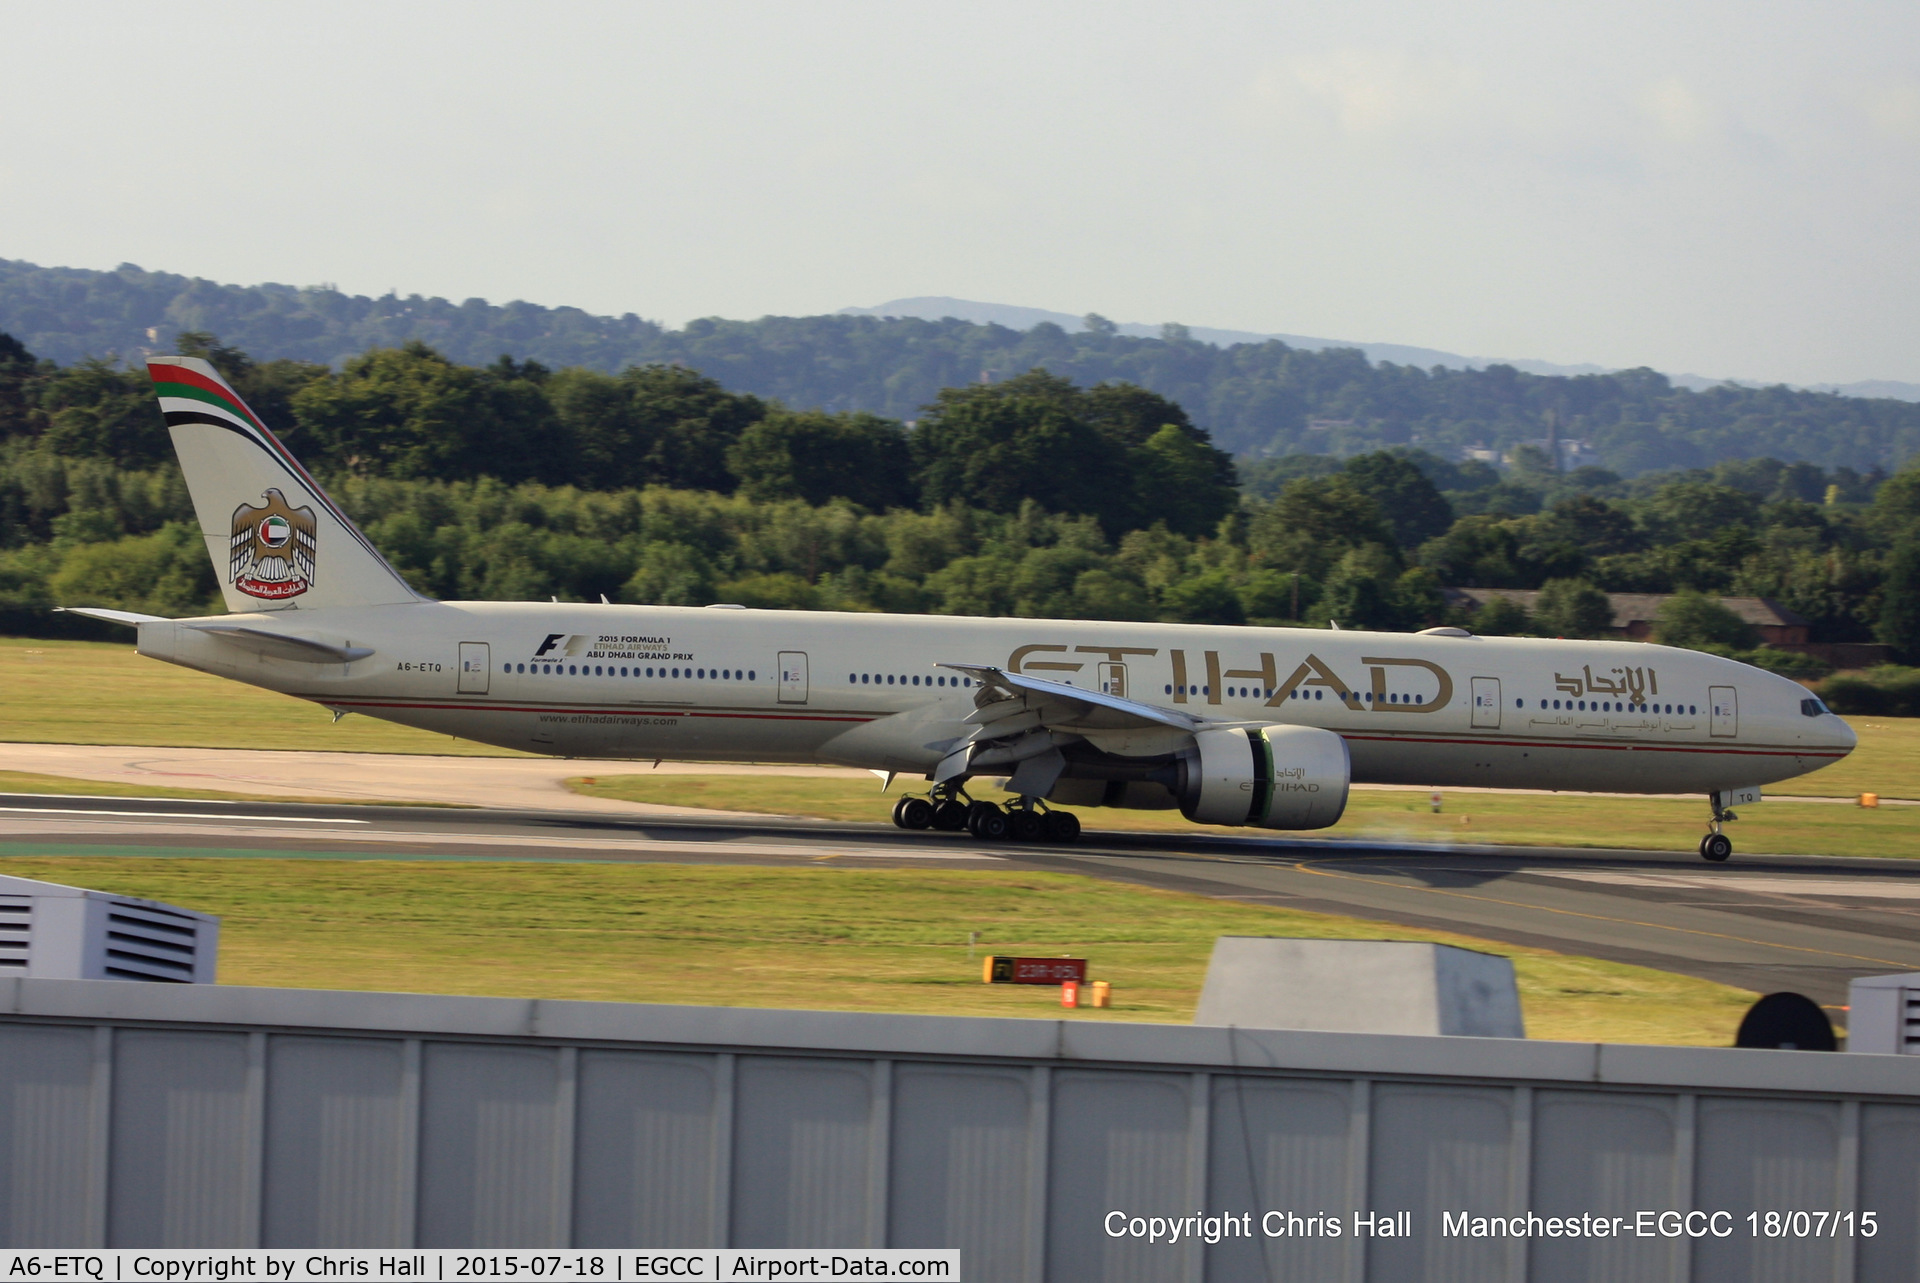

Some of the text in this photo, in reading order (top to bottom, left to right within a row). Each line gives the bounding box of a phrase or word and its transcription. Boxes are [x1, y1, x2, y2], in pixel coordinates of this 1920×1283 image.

[599, 635, 618, 643] 2015
[621, 636, 663, 644] FORMULA
[586, 651, 694, 661] ABU DHABI GRAND PRIX
[397, 662, 442, 672] A6-ETQ
[1008, 643, 1454, 713] ETIHAD
[539, 714, 678, 726] www.etihadairways.com
